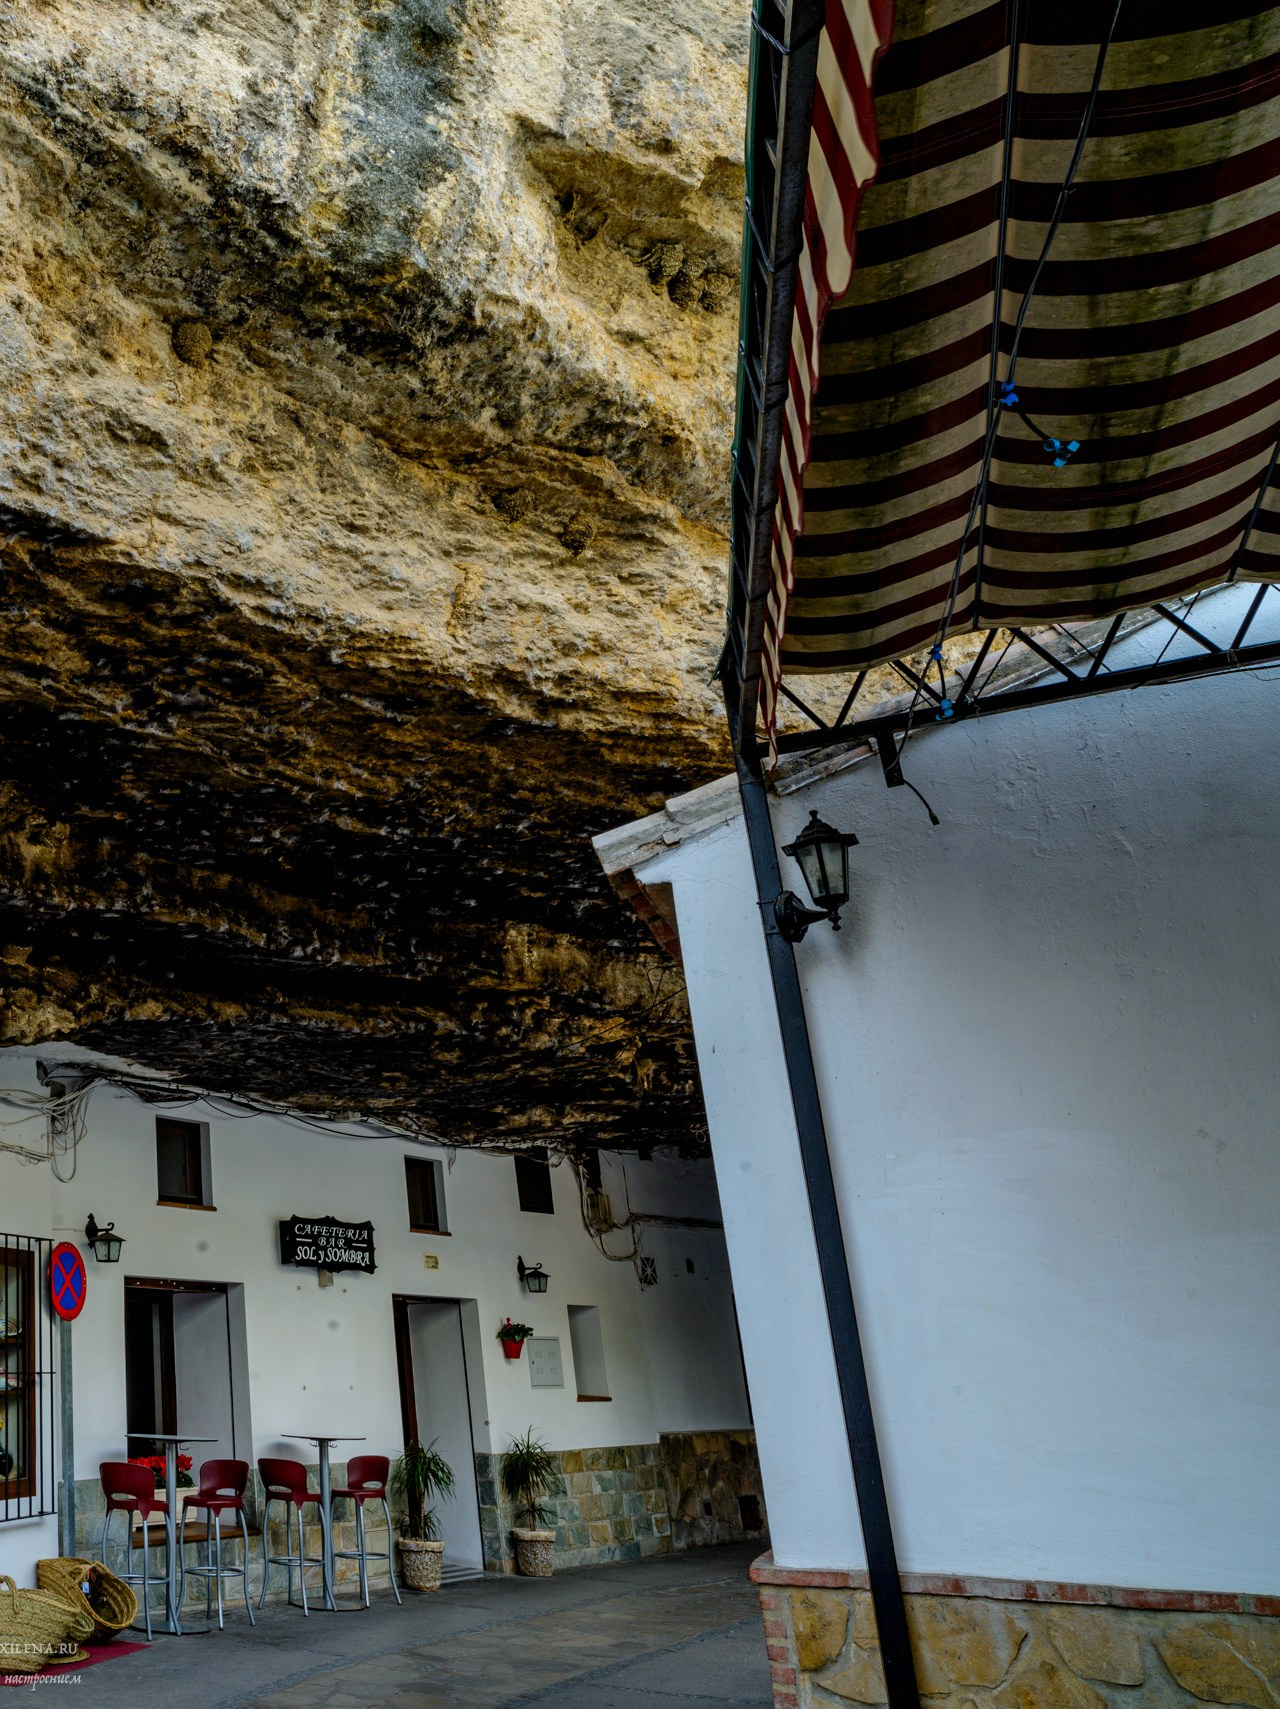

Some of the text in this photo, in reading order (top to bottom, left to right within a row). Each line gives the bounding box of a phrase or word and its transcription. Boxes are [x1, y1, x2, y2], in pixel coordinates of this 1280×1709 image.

[295, 1223, 368, 1240] CAFETERIA
[318, 1236, 347, 1249] BAR
[295, 1246, 370, 1267] SOL y SOMBRA
